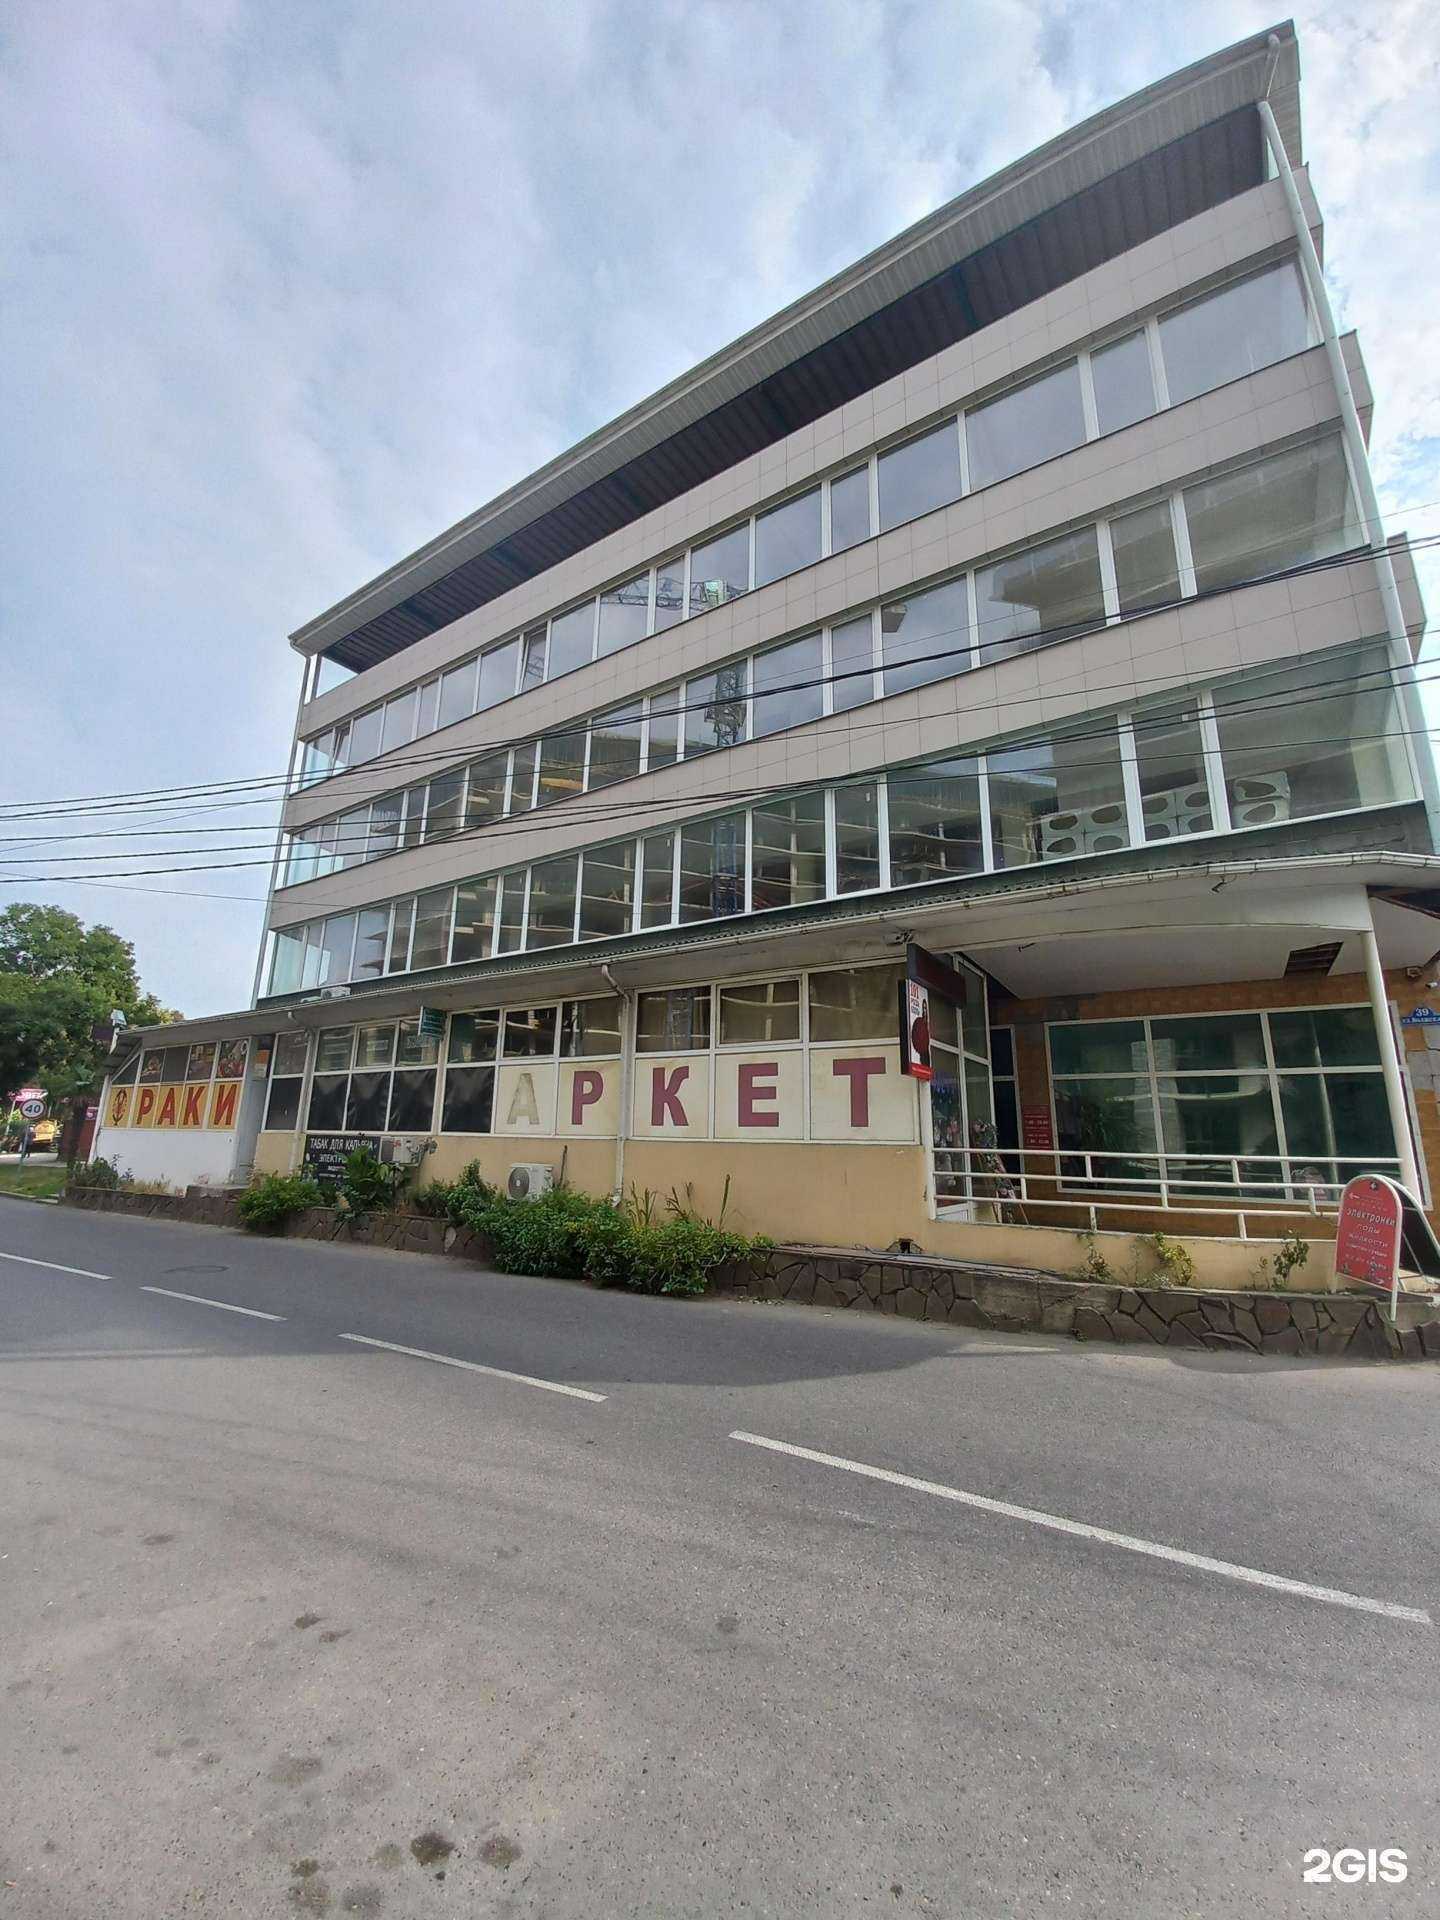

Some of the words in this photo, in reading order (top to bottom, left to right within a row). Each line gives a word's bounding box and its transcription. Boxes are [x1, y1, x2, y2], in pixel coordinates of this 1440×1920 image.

[1415, 1007, 1429, 1017] 39
[25, 1104, 41, 1114] 40
[136, 1084, 238, 1125] РАКИ
[310, 1137, 329, 1150] ТАБАК
[328, 1138, 344, 1150] ДЛЯ
